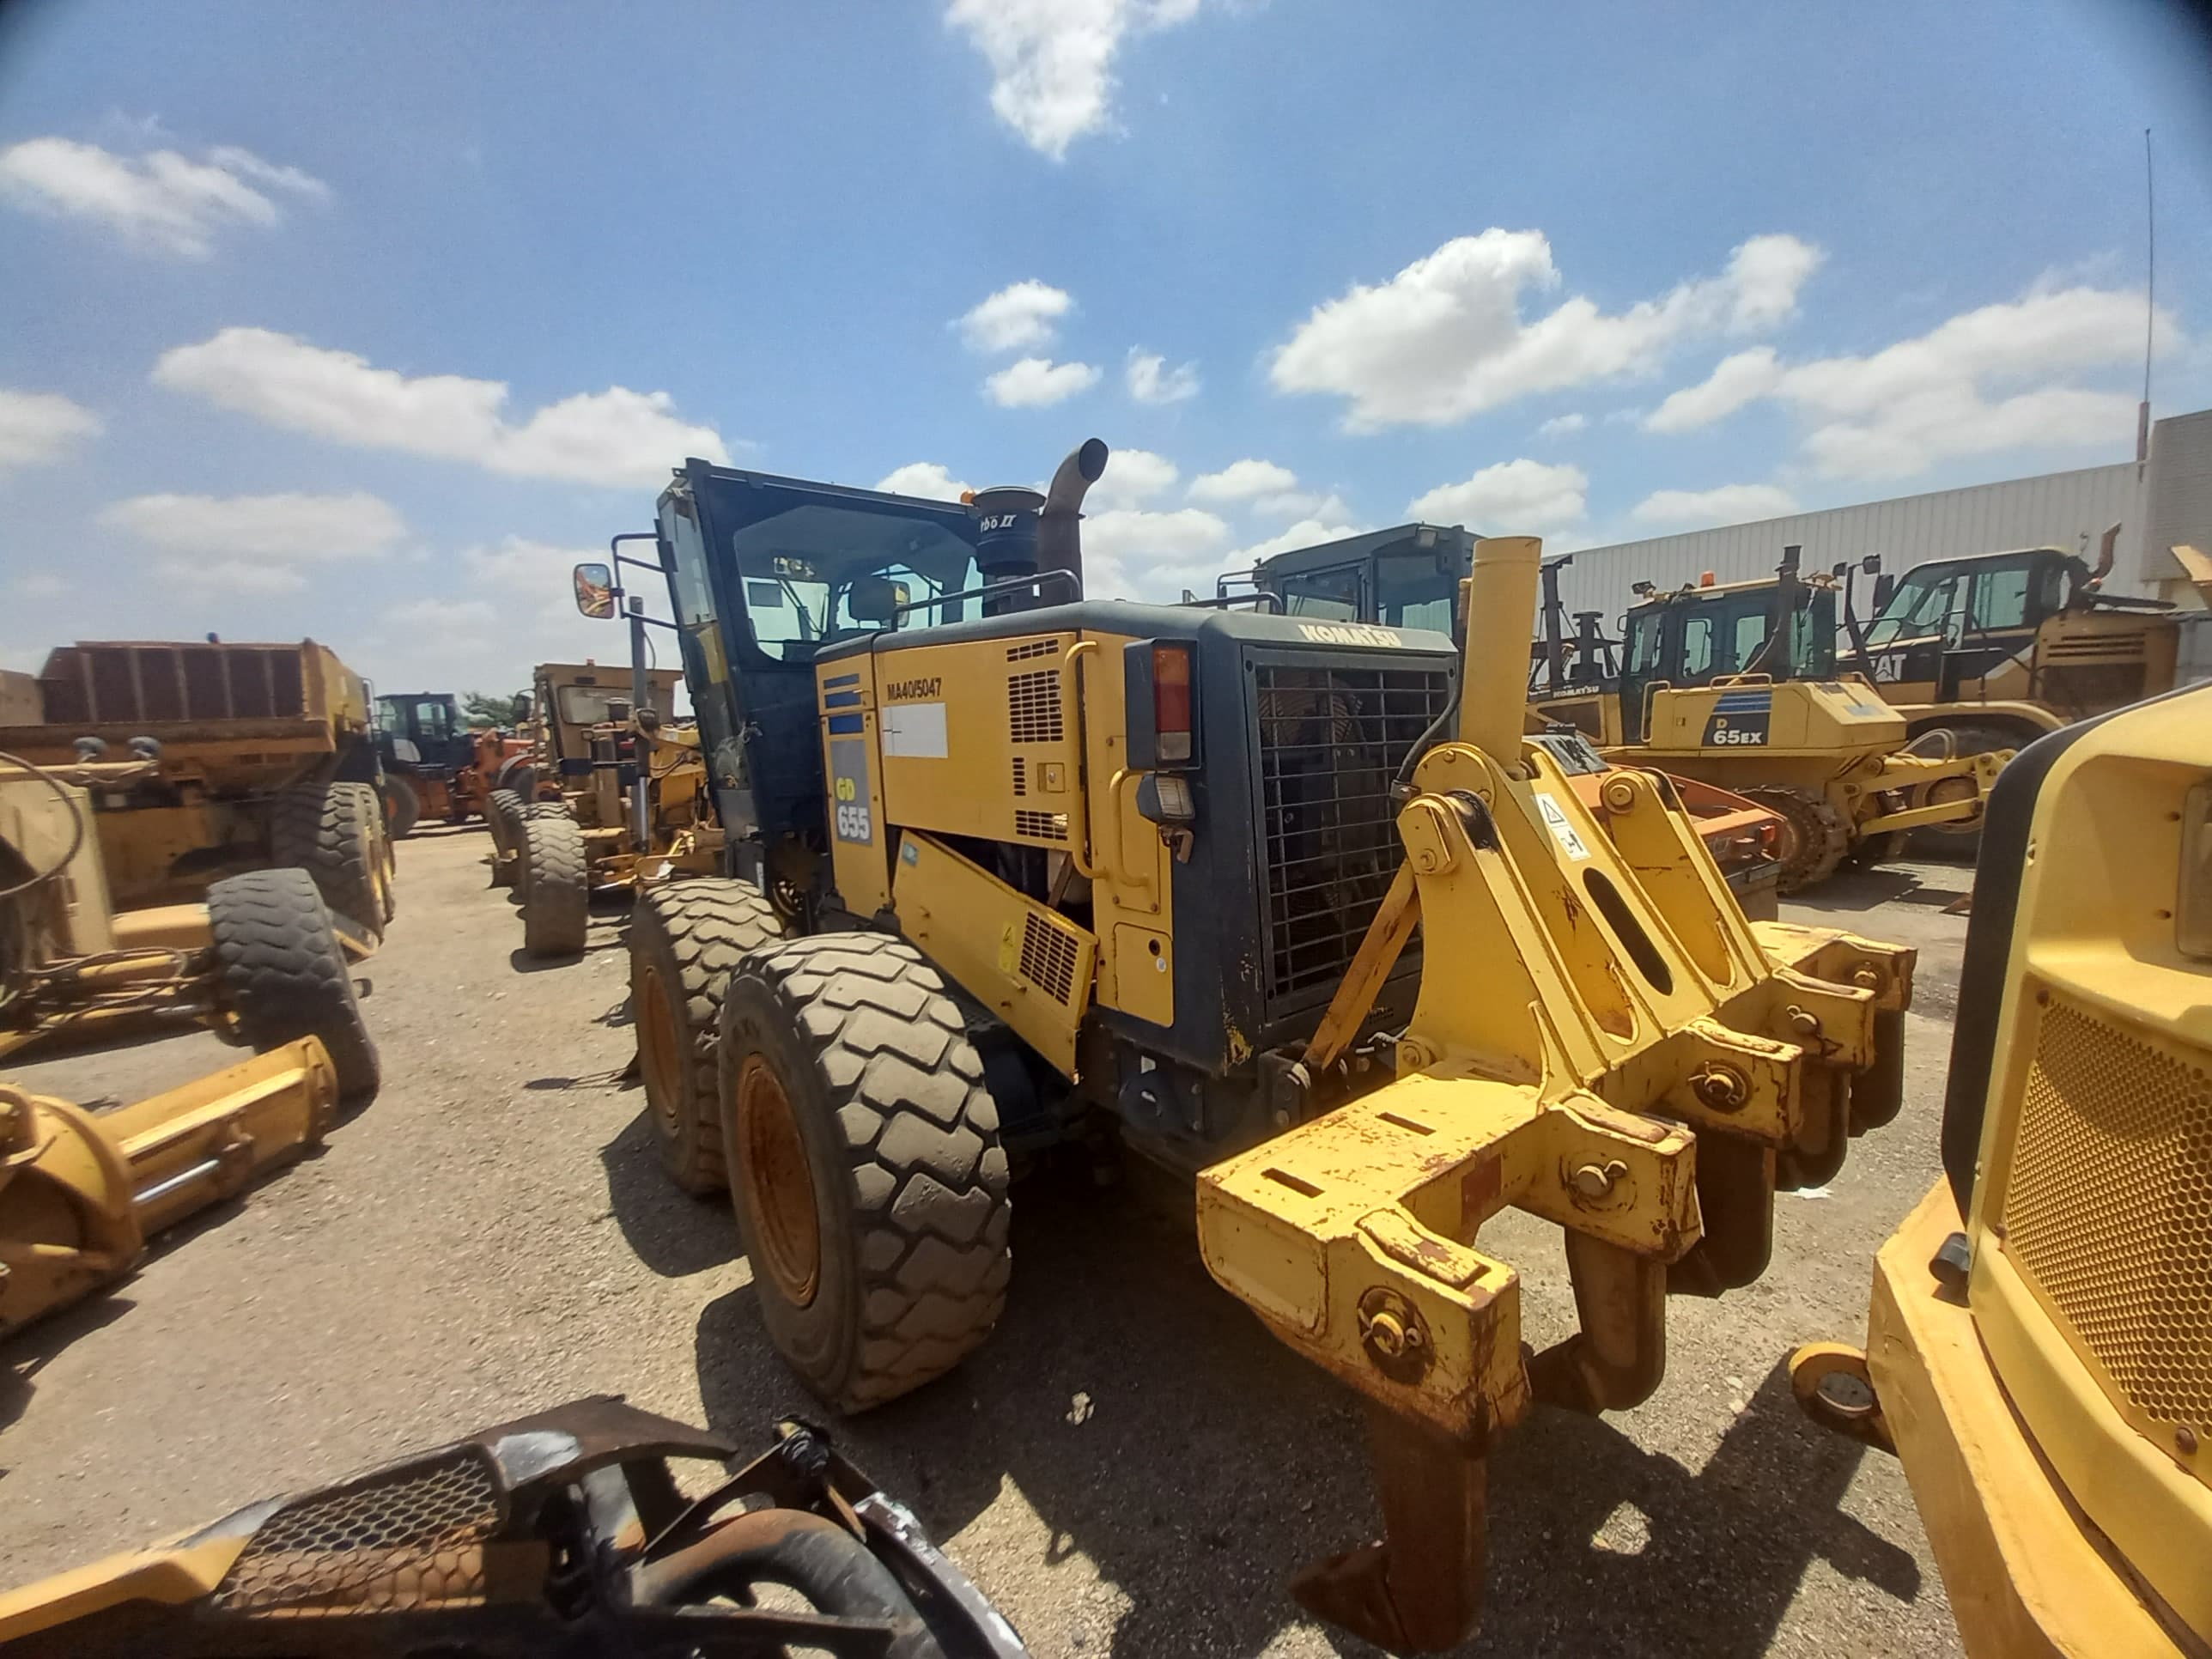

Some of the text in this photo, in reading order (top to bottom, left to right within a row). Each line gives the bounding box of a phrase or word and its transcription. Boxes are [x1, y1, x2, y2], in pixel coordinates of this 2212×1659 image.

[1297, 624, 1402, 647] KOMATSU
[1869, 653, 1907, 683] AT
[1553, 685, 1600, 699] KOMATSU
[1716, 718, 1728, 729] D
[1713, 729, 1763, 744] 65EX
[836, 776, 855, 801] GD
[837, 805, 871, 840] 655
